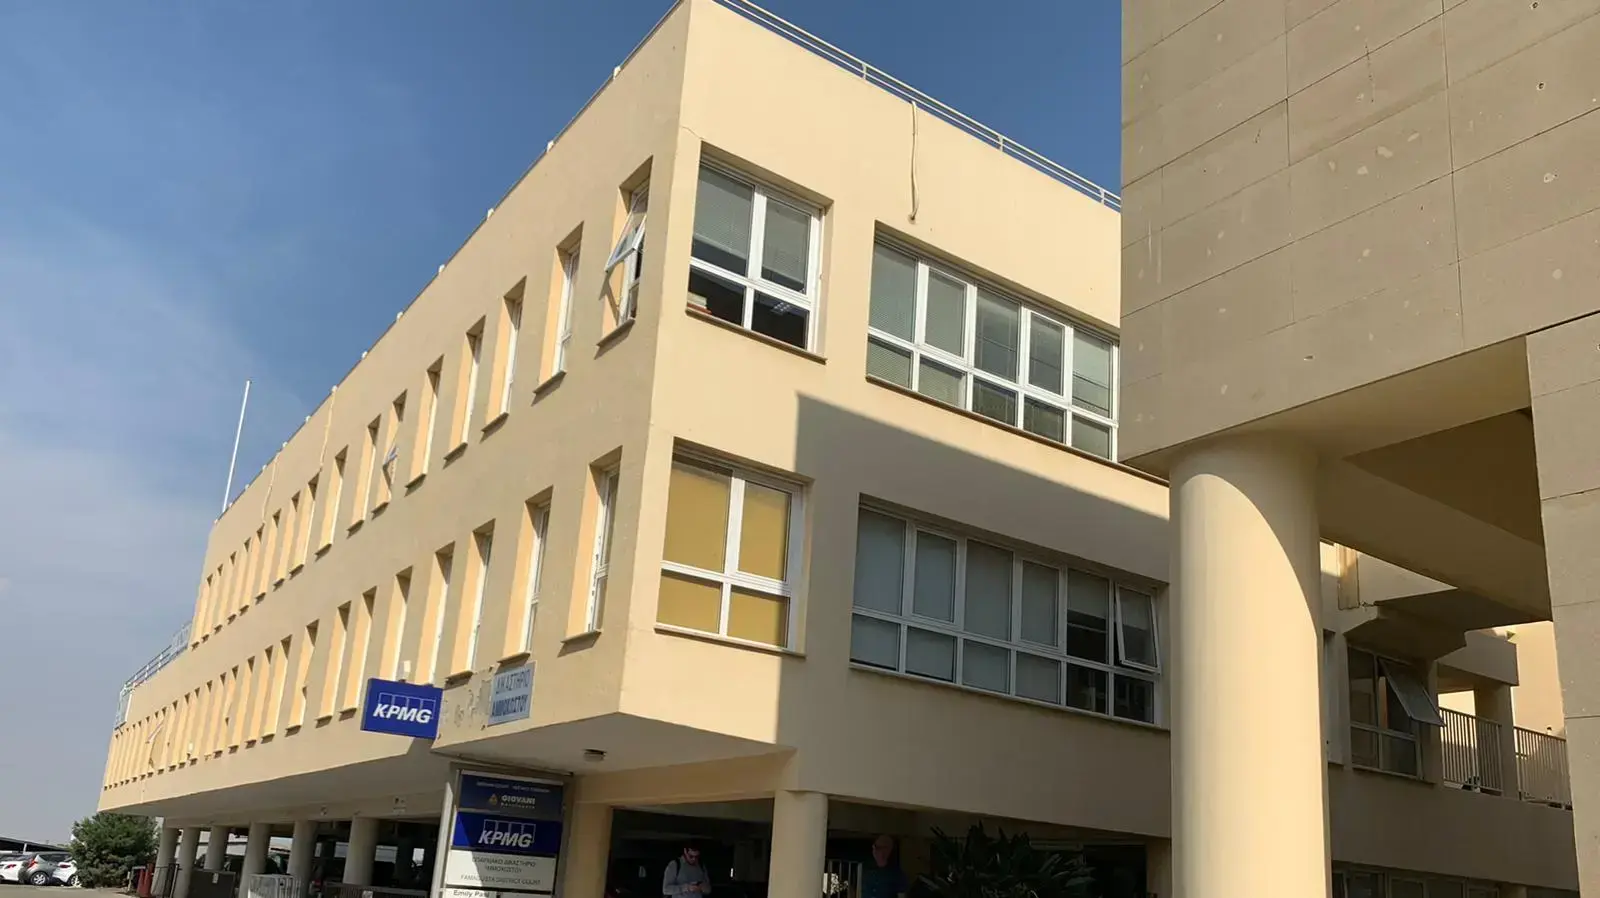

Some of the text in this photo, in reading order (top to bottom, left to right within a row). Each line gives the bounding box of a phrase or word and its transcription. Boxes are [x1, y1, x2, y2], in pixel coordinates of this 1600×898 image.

[373, 704, 432, 724] KPMG
[501, 794, 536, 805] GIOVANI
[478, 830, 533, 848] KPMG
